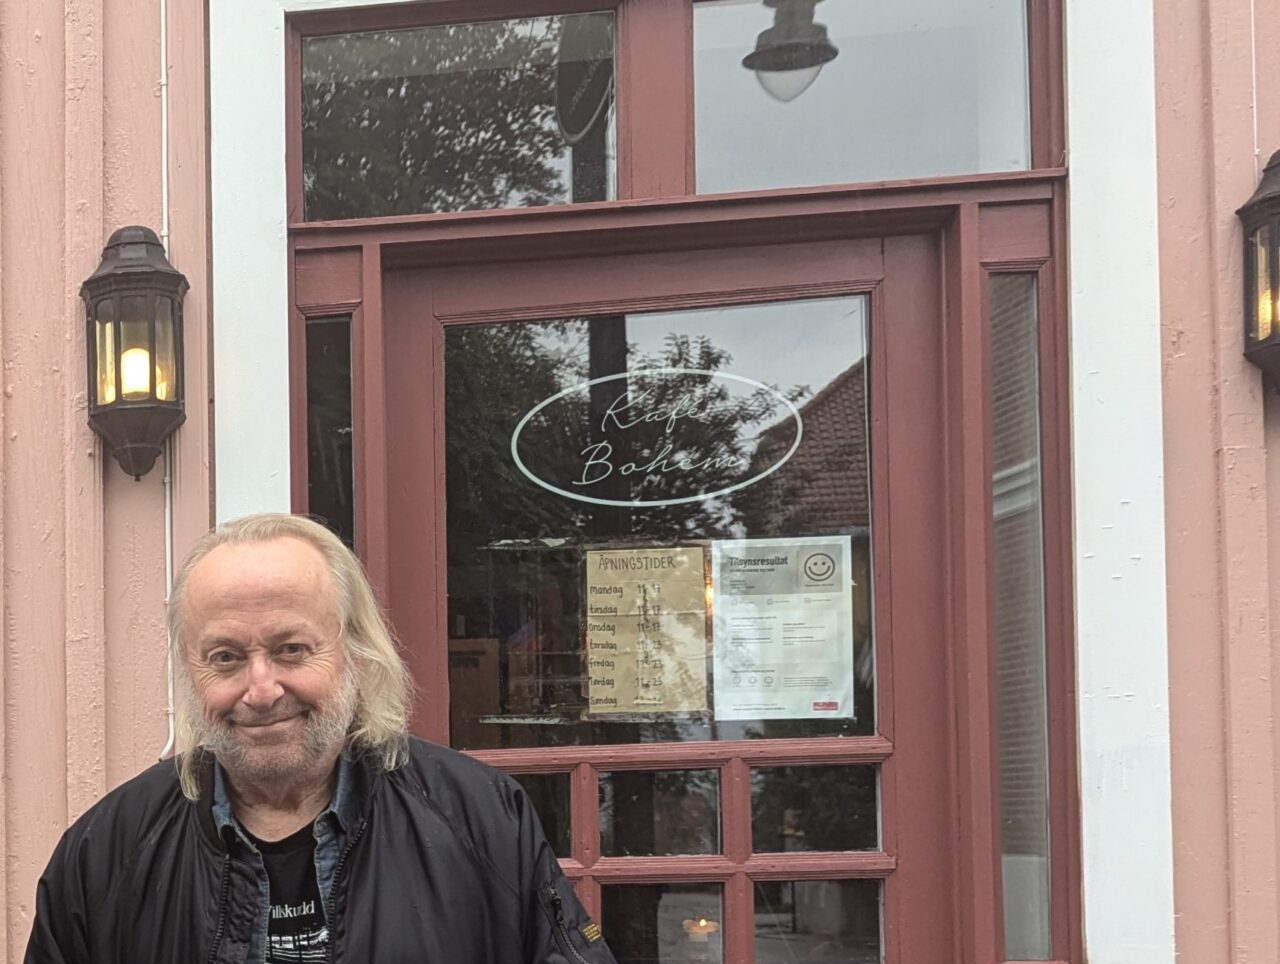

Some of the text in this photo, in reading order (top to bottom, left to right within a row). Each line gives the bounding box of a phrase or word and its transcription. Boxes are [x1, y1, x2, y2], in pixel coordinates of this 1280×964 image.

[572, 440, 745, 486] Bohem
[598, 554, 676, 571] ÅPNINGSTIDER
[588, 657, 615, 671] fredag
